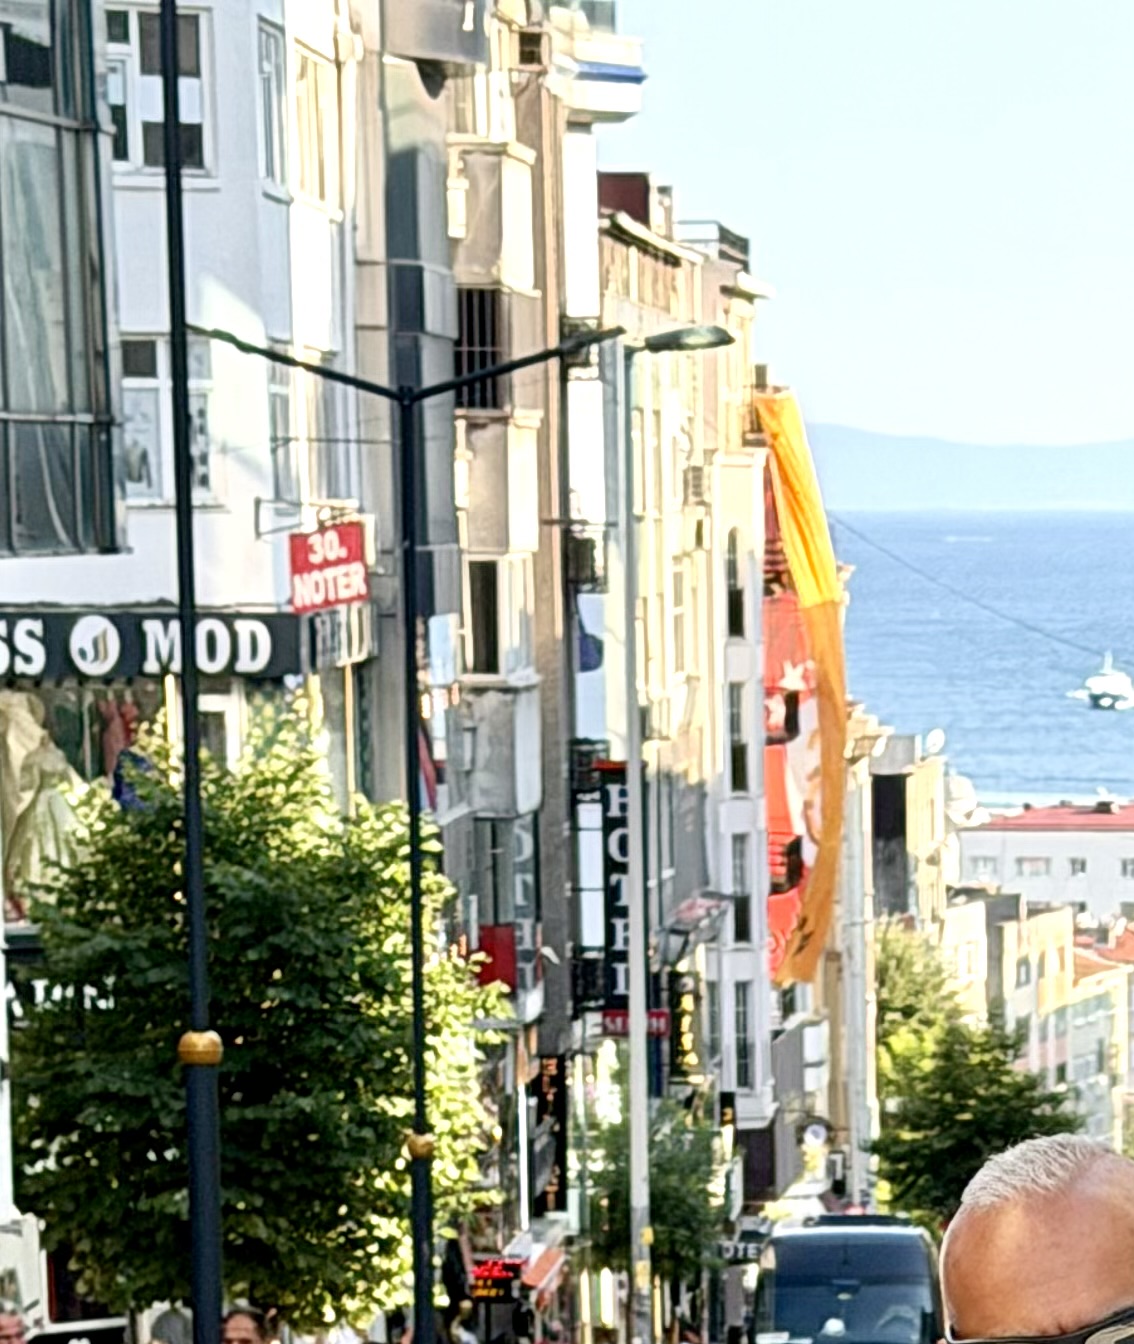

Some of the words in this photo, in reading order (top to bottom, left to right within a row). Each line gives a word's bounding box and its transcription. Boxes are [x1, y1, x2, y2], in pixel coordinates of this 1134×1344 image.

[308, 532, 348, 563] 30.
[293, 561, 367, 607] NOTER
[143, 618, 271, 674] MOD
